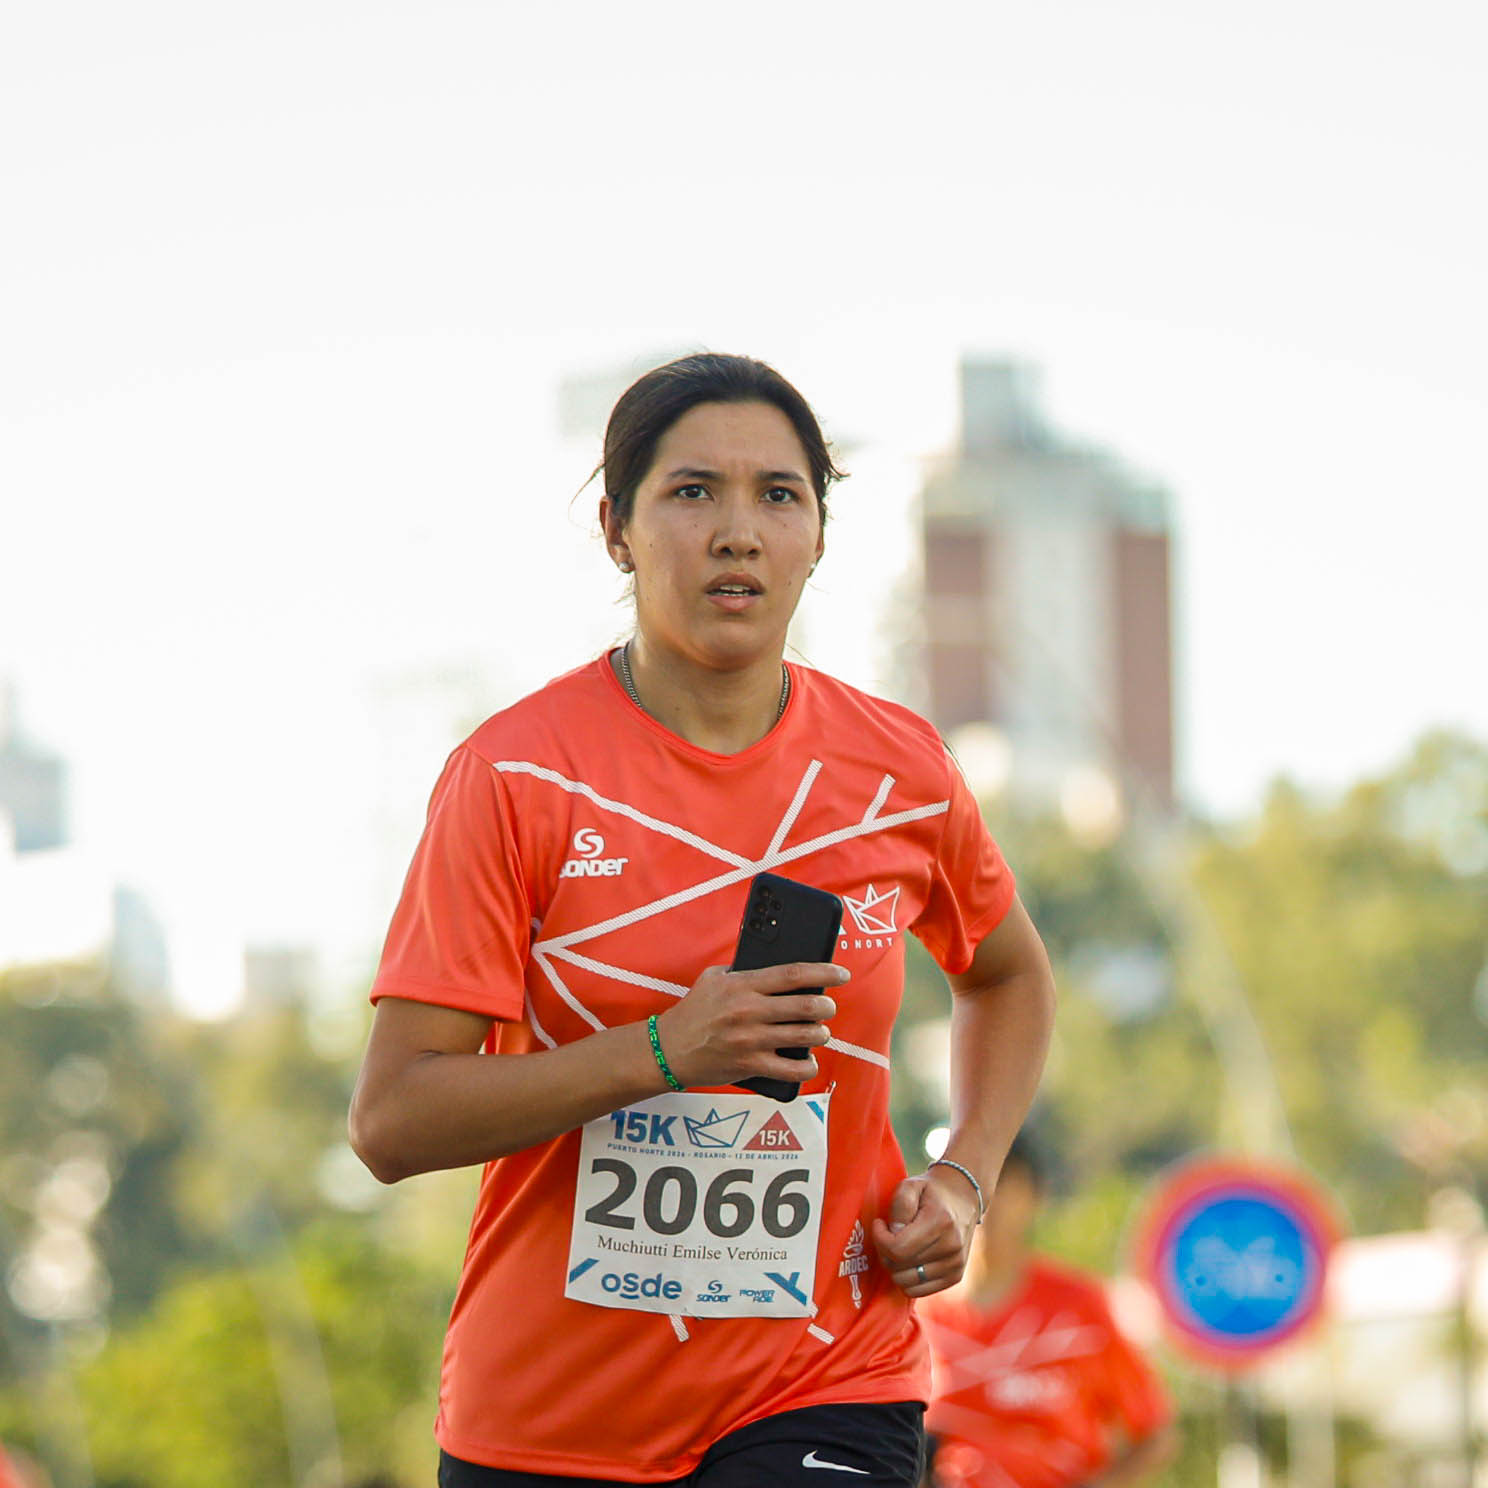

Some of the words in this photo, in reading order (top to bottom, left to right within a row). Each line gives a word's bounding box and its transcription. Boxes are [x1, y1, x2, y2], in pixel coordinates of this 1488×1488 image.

[610, 1109, 678, 1146] 15K
[759, 1129, 791, 1147] 15K
[584, 1158, 811, 1239] 2066
[597, 1234, 669, 1257] Muchiutti
[672, 1243, 722, 1261] Emilse
[727, 1246, 788, 1261] Verónica
[601, 1272, 682, 1299] osde
